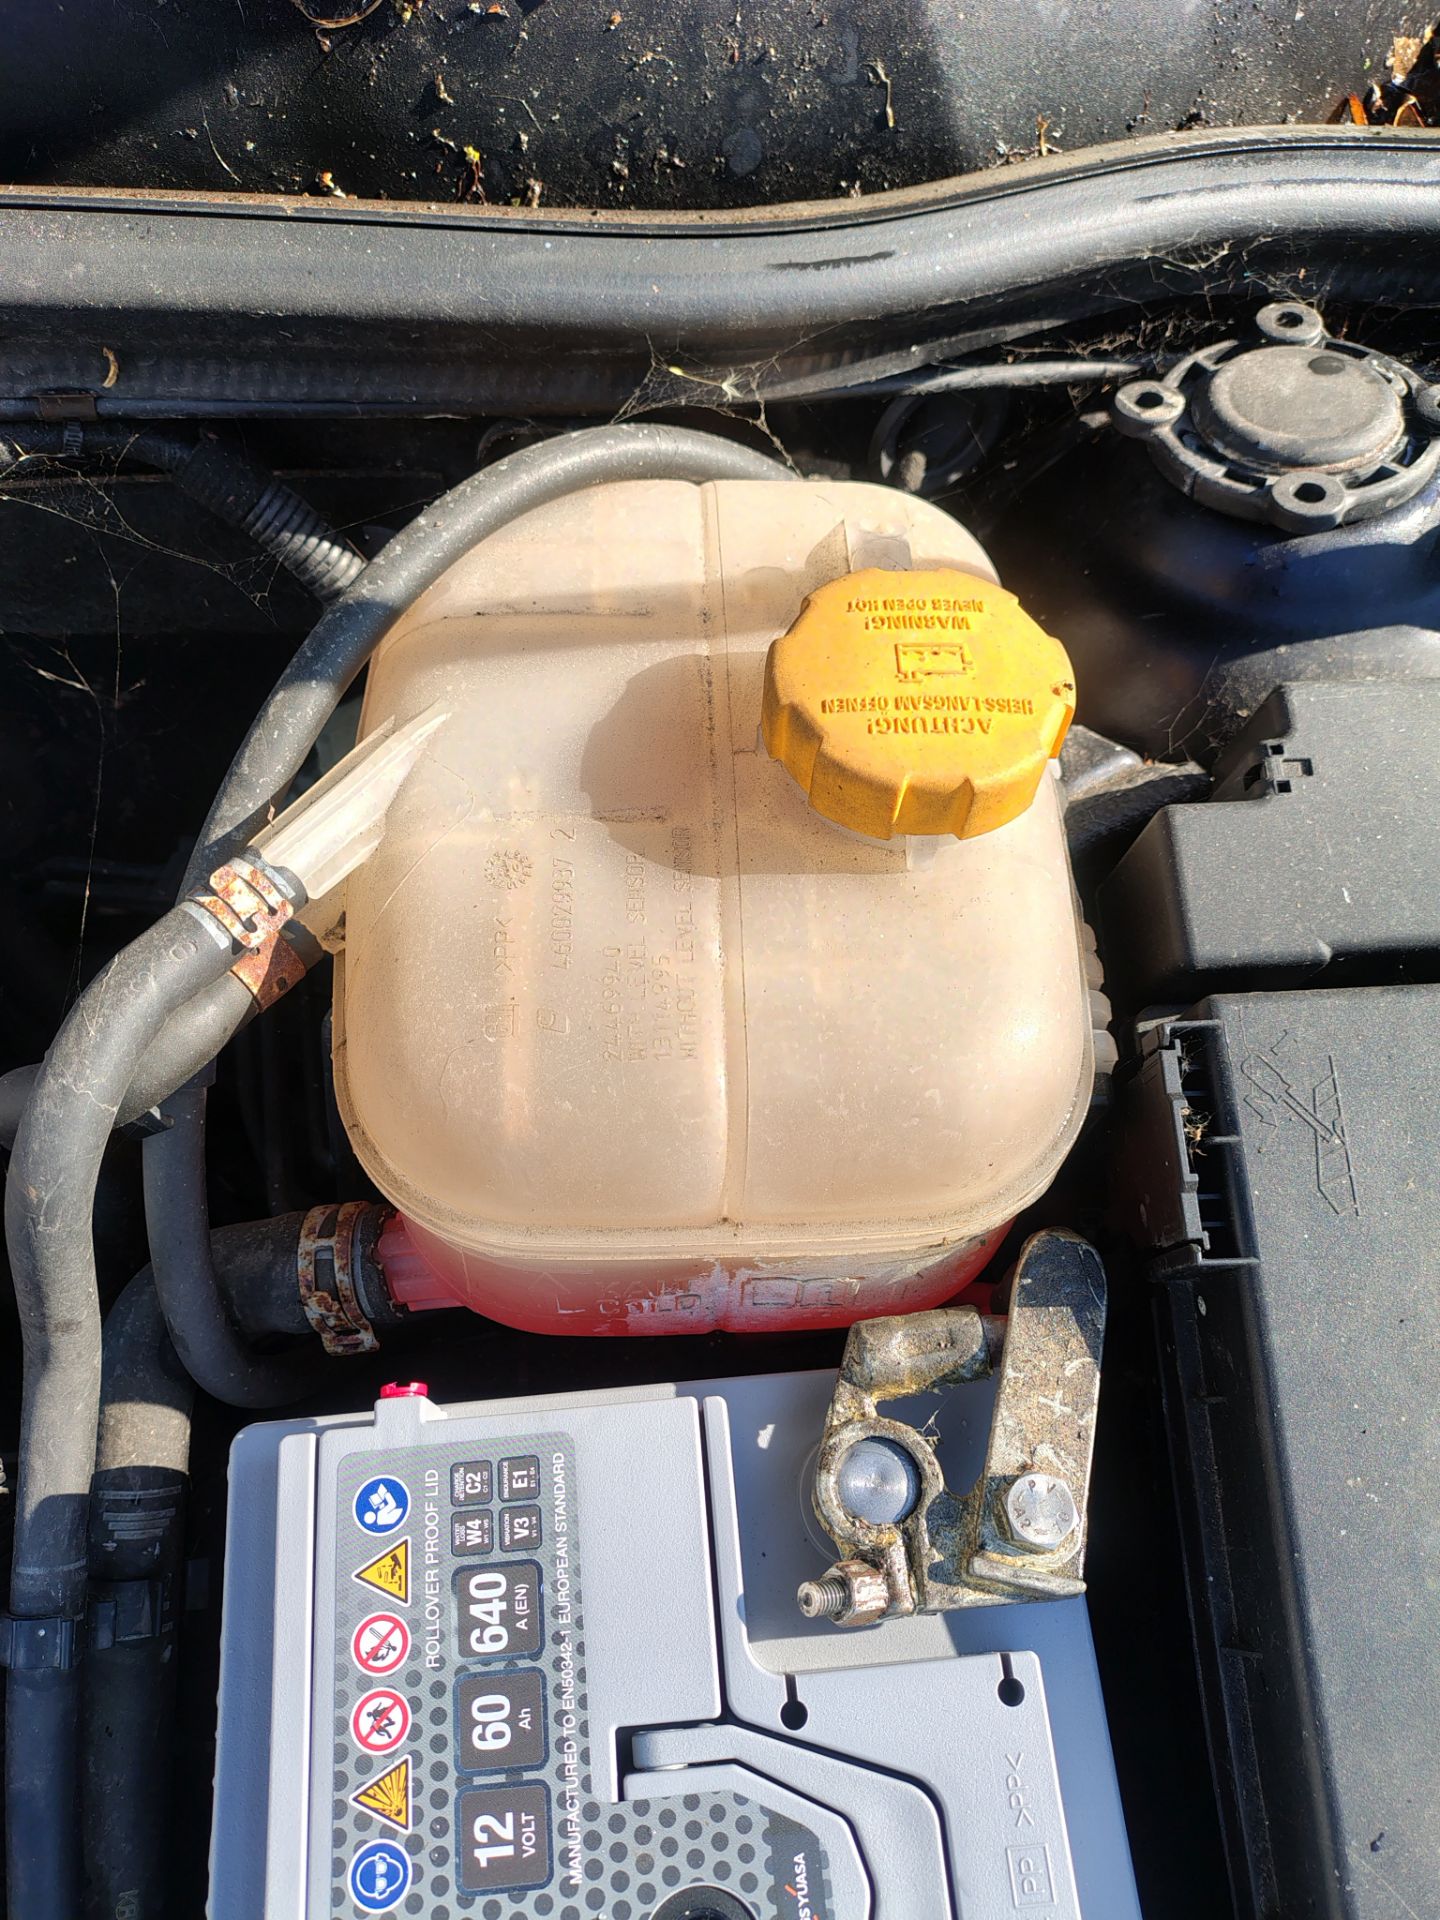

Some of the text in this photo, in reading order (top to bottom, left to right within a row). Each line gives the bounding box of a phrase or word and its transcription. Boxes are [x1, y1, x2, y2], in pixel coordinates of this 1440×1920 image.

[846, 598, 985, 614] NEVER OPEN HOT
[864, 614, 972, 631] WARNING!
[821, 696, 889, 716] ÖFFNEN
[867, 717, 993, 735] ACHTUNG!
[672, 827, 693, 893] SENSOR
[675, 901, 694, 963] LEVEL
[627, 935, 646, 998] LEVEL
[465, 1471, 482, 1494] C2
[512, 1470, 528, 1489] E1
[466, 1518, 482, 1547] W4
[513, 1516, 530, 1540] V3
[425, 1469, 441, 1668] ROLLOVER PROOF LID
[469, 1572, 509, 1653] 640
[514, 1584, 530, 1630] A (EN)
[552, 1452, 583, 1885] MANUFACTURED TO EN50342-1 EUROPEAN STANDARD
[471, 1694, 511, 1750] 60
[518, 1707, 532, 1730] Ah
[1005, 1752, 1035, 1827] >PP<
[474, 1811, 515, 1868] 12
[521, 1812, 537, 1859] VOLT
[1019, 1857, 1046, 1896] PP
